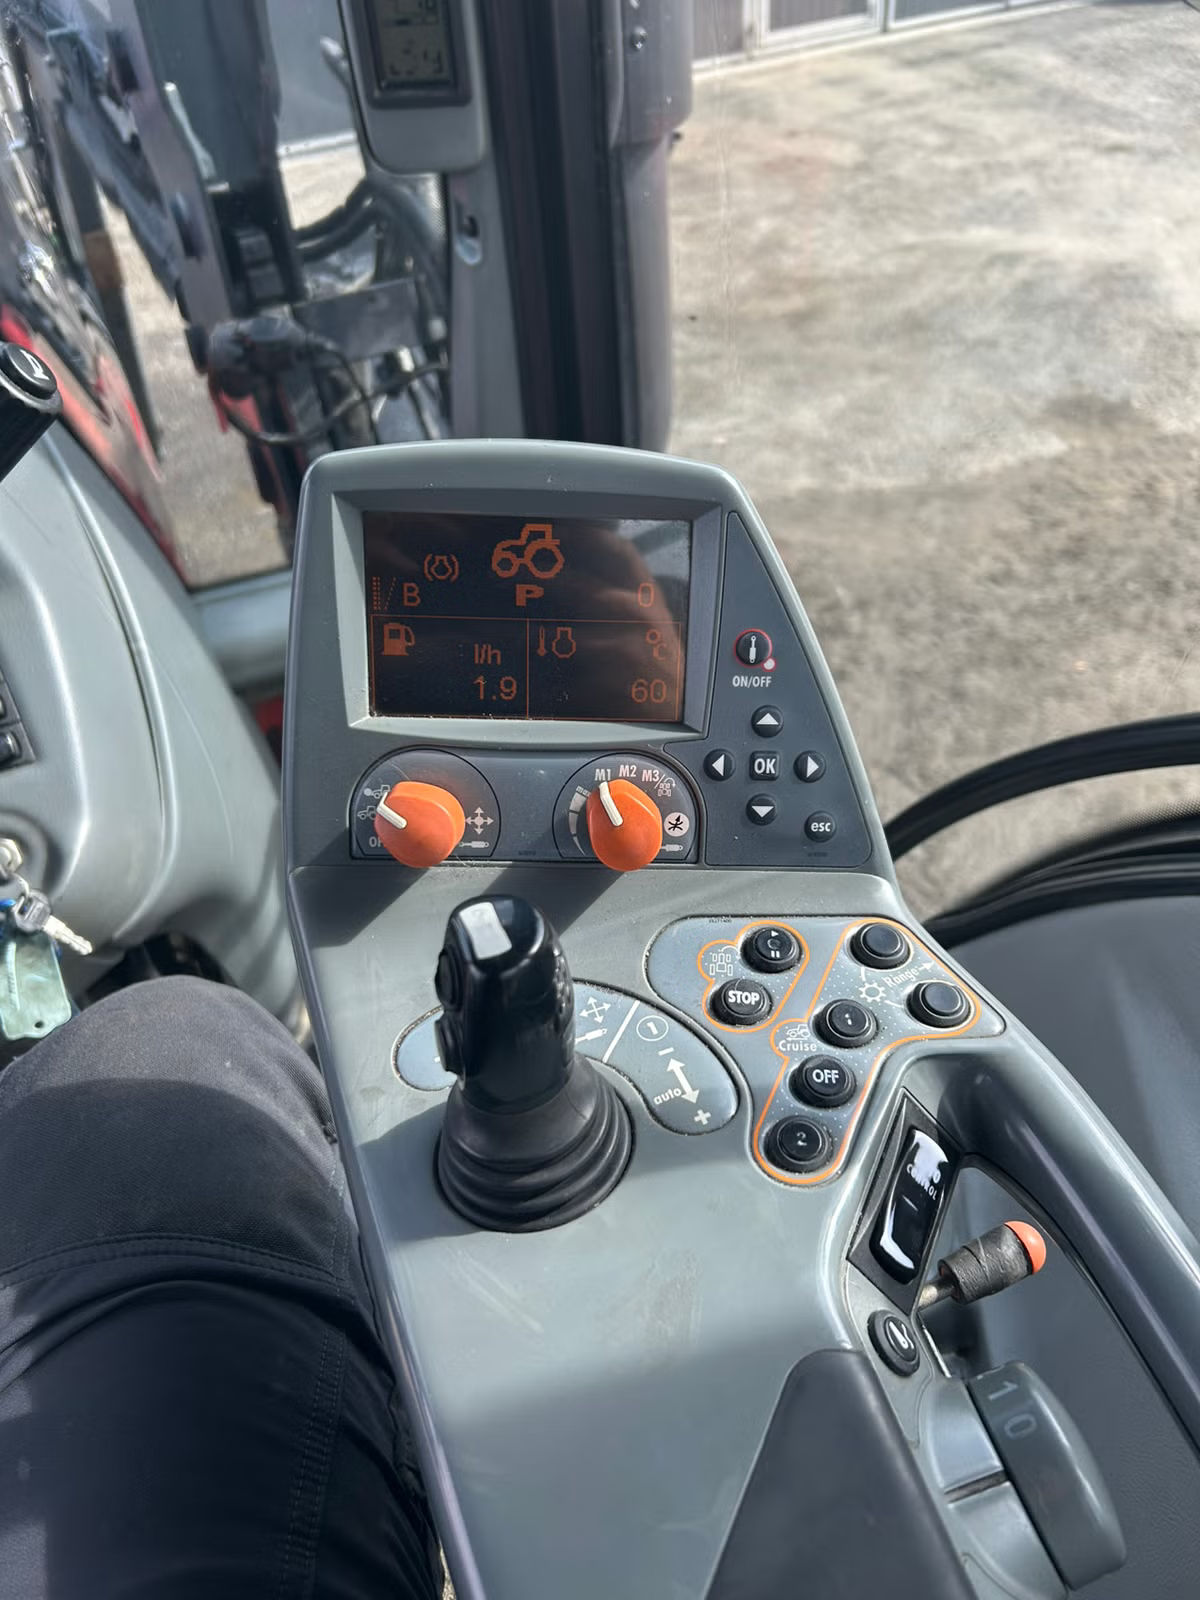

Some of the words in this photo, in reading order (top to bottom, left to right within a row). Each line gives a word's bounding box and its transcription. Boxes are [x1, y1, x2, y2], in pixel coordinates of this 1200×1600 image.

[403, 582, 421, 607] B
[515, 584, 545, 607] P
[473, 675, 517, 701] 1.9
[732, 675, 772, 688] ON/OFF
[631, 678, 667, 704] 60
[595, 768, 612, 781] M1
[618, 764, 638, 778] M2
[754, 758, 776, 775] OK
[810, 821, 831, 832] esc
[882, 967, 920, 988] Range
[728, 990, 760, 1005] STOP
[778, 1040, 818, 1052] Cruise
[812, 1068, 840, 1084] OFF
[653, 1087, 683, 1105] auto
[796, 1131, 808, 1147] 2
